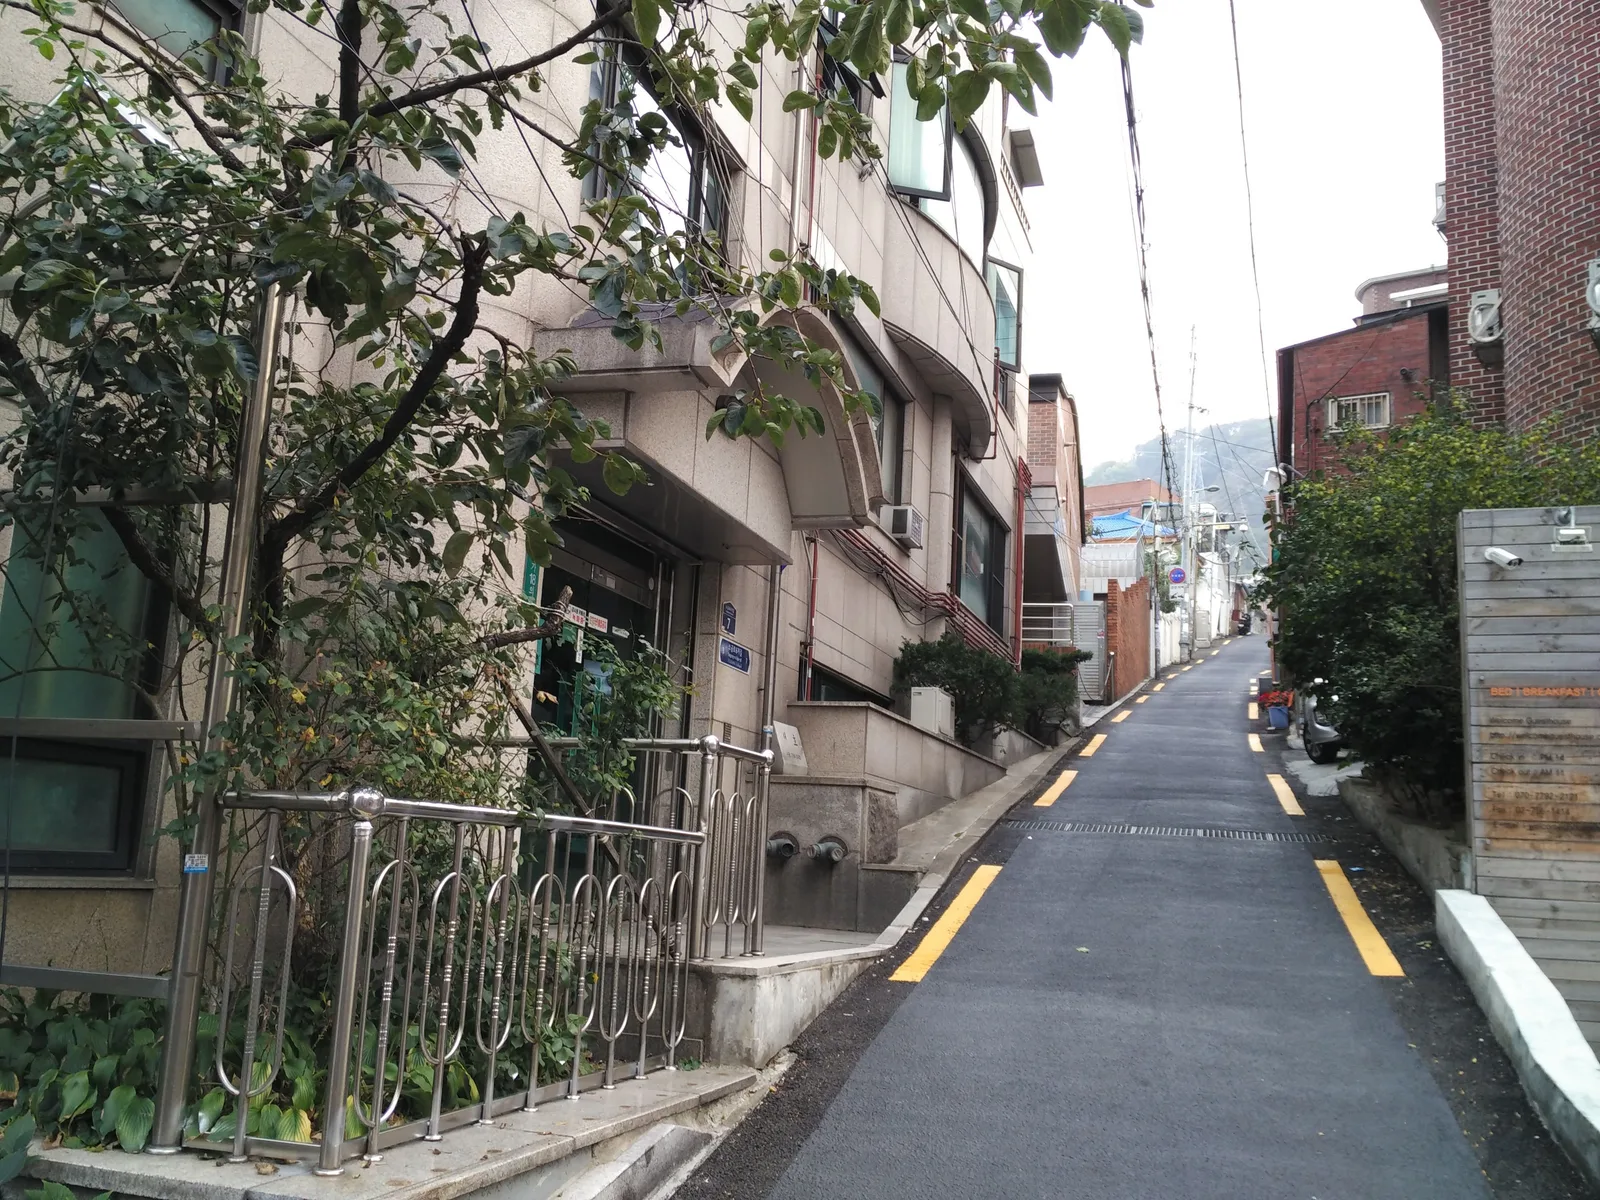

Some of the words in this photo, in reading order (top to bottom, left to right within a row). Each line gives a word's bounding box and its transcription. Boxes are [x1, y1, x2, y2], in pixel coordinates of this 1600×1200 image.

[726, 618, 731, 629] 7
[1490, 687, 1512, 696] BED
[1522, 687, 1586, 697] BREAKFAST
[1526, 716, 1572, 726] Guesthouse
